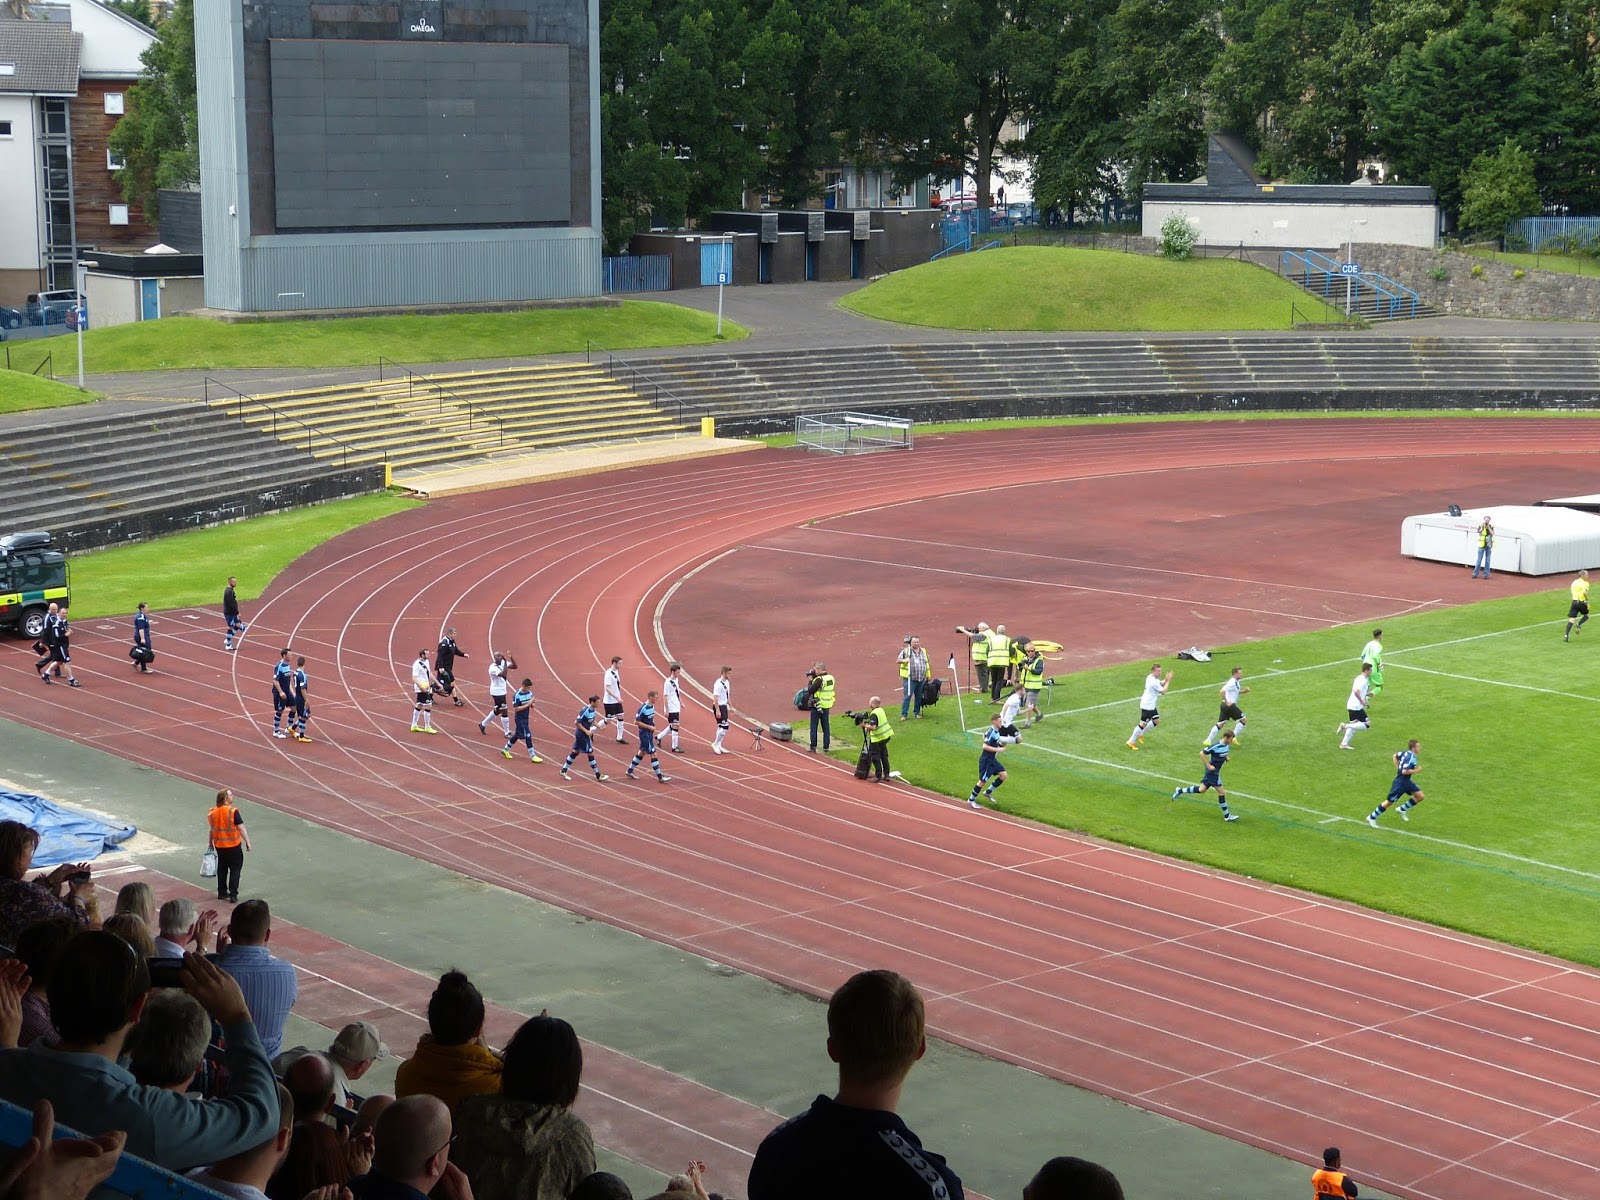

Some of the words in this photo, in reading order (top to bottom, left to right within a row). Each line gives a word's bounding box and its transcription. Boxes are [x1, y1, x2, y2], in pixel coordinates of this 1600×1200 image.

[410, 24, 435, 32] OMEGA
[1342, 264, 1358, 273] CDE
[719, 273, 726, 282] B
